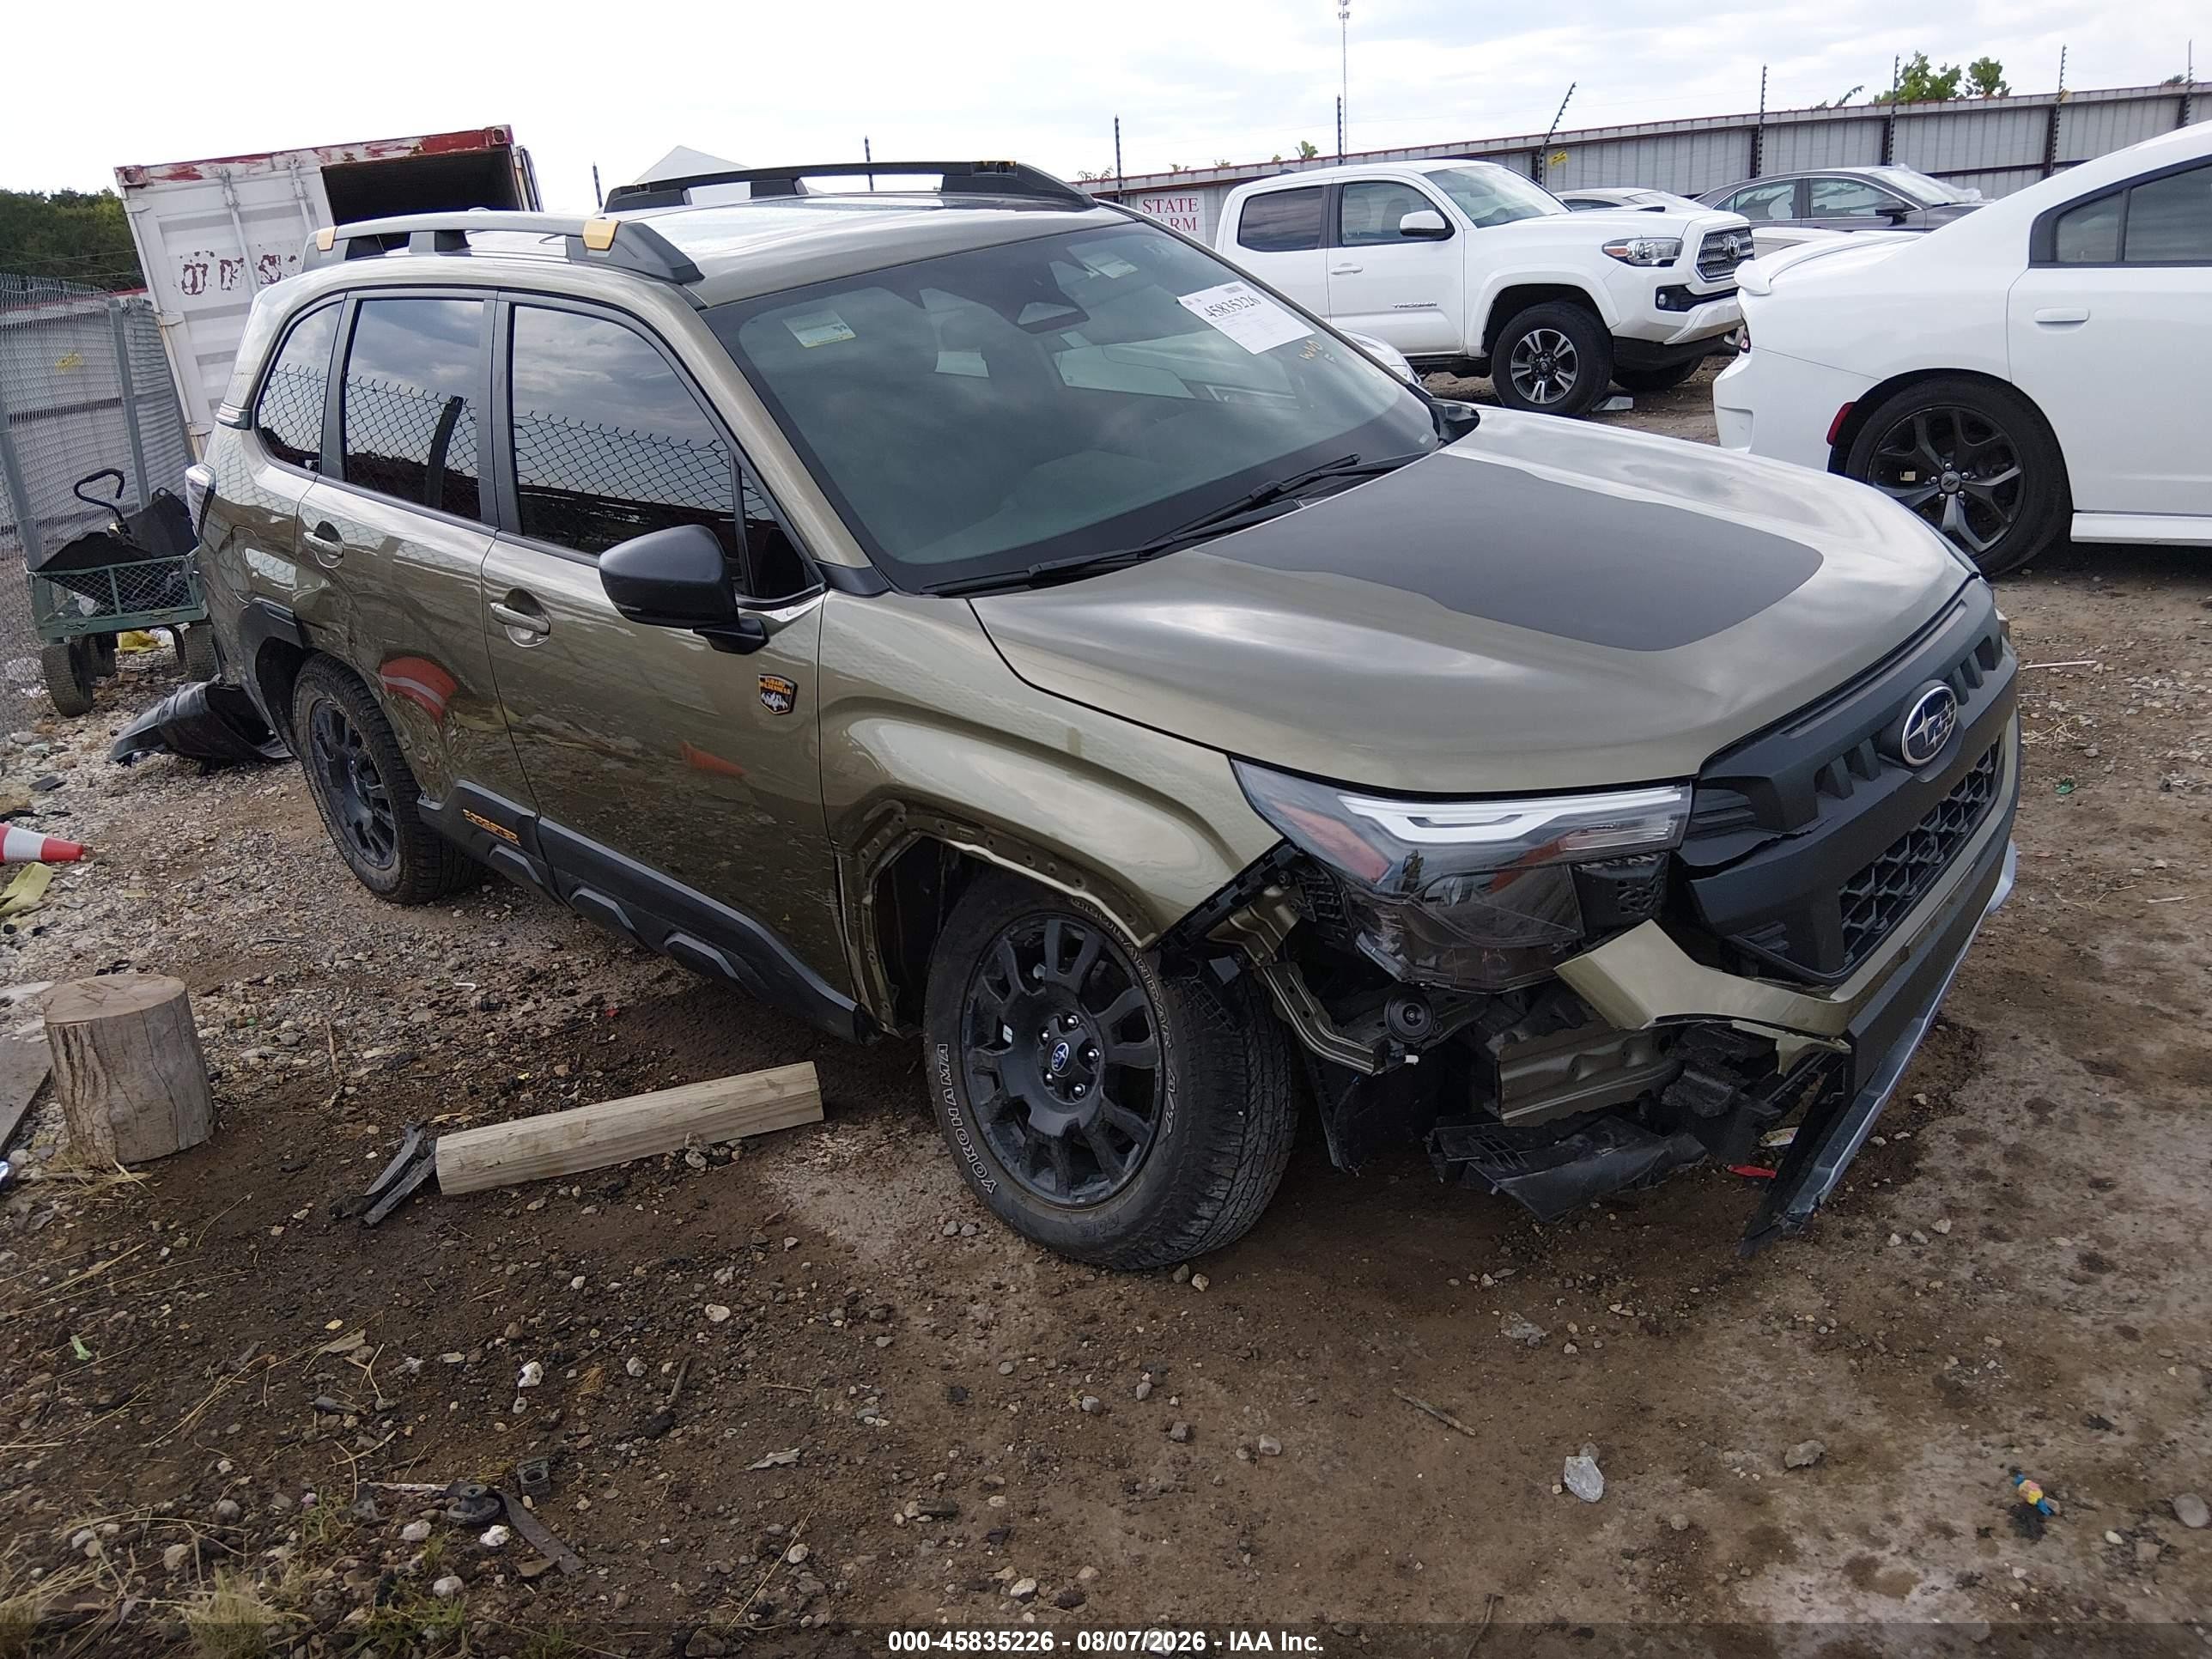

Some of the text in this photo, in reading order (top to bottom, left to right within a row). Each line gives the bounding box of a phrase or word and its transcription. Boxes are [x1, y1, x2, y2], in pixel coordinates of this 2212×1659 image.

[1142, 198, 1200, 214] STATE
[1204, 295, 1261, 318] 45835226
[937, 1043, 998, 1194] YOKOHAMA
